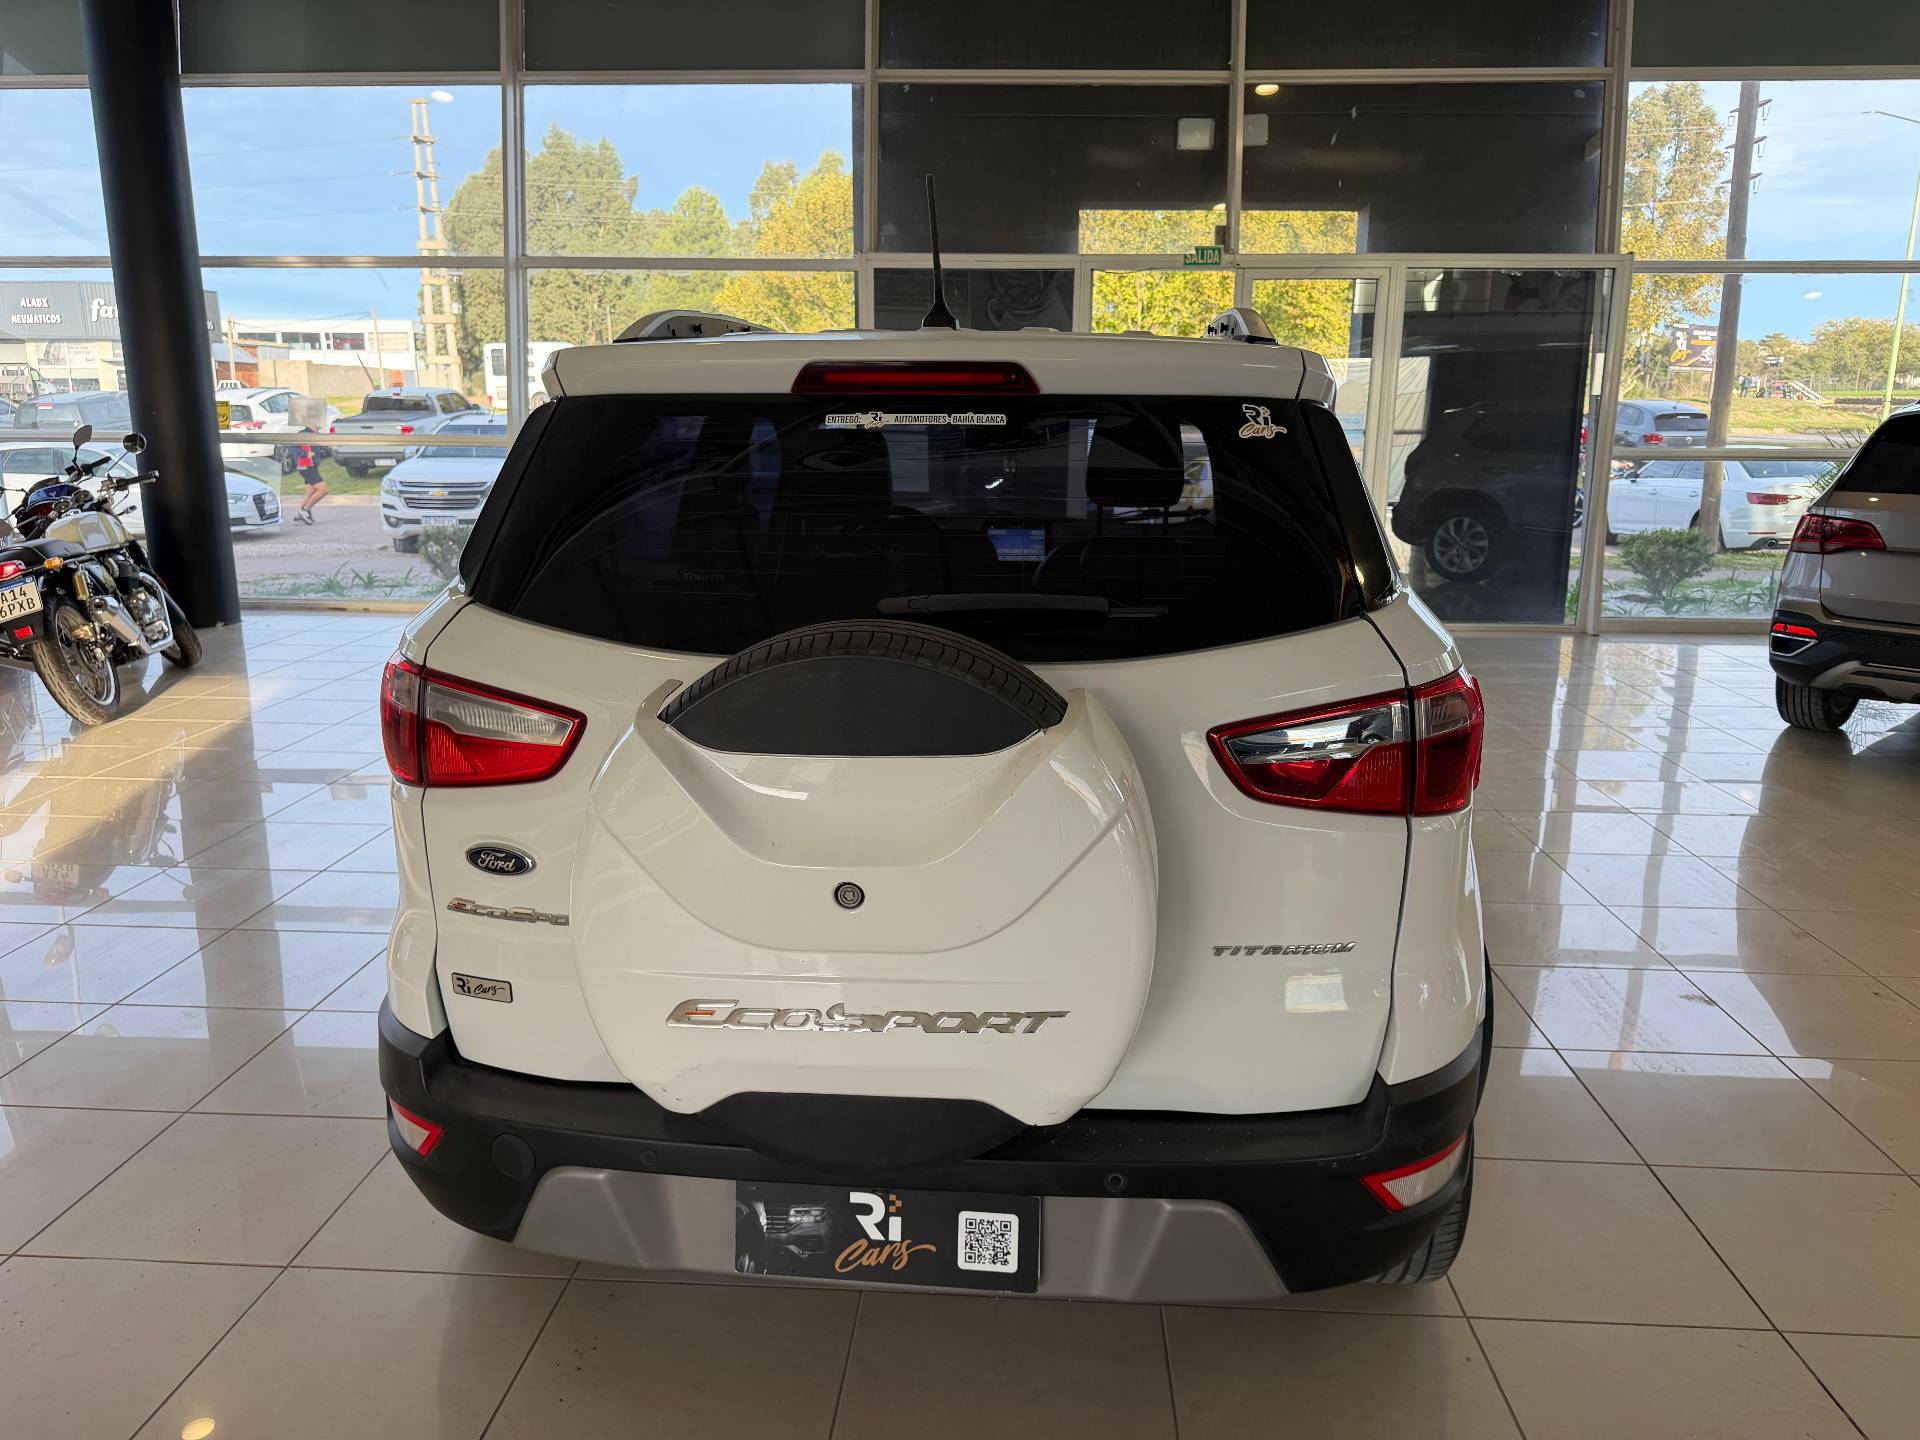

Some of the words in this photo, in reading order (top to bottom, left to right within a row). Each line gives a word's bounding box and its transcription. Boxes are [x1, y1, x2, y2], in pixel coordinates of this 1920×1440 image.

[1185, 249, 1220, 265] SALIDA
[11, 313, 62, 325] NEUMATICOS
[894, 415, 947, 424] AUTOMOTORES
[976, 415, 1005, 424] BLANCA
[1239, 422, 1287, 439] Cars
[0, 586, 27, 605] A14
[0, 597, 36, 618] 6PXB
[477, 850, 516, 872] Ford
[1212, 941, 1357, 957] TITANIUM
[473, 984, 506, 996] Cars
[849, 1191, 902, 1242] Ri
[834, 1238, 937, 1273] Cars
